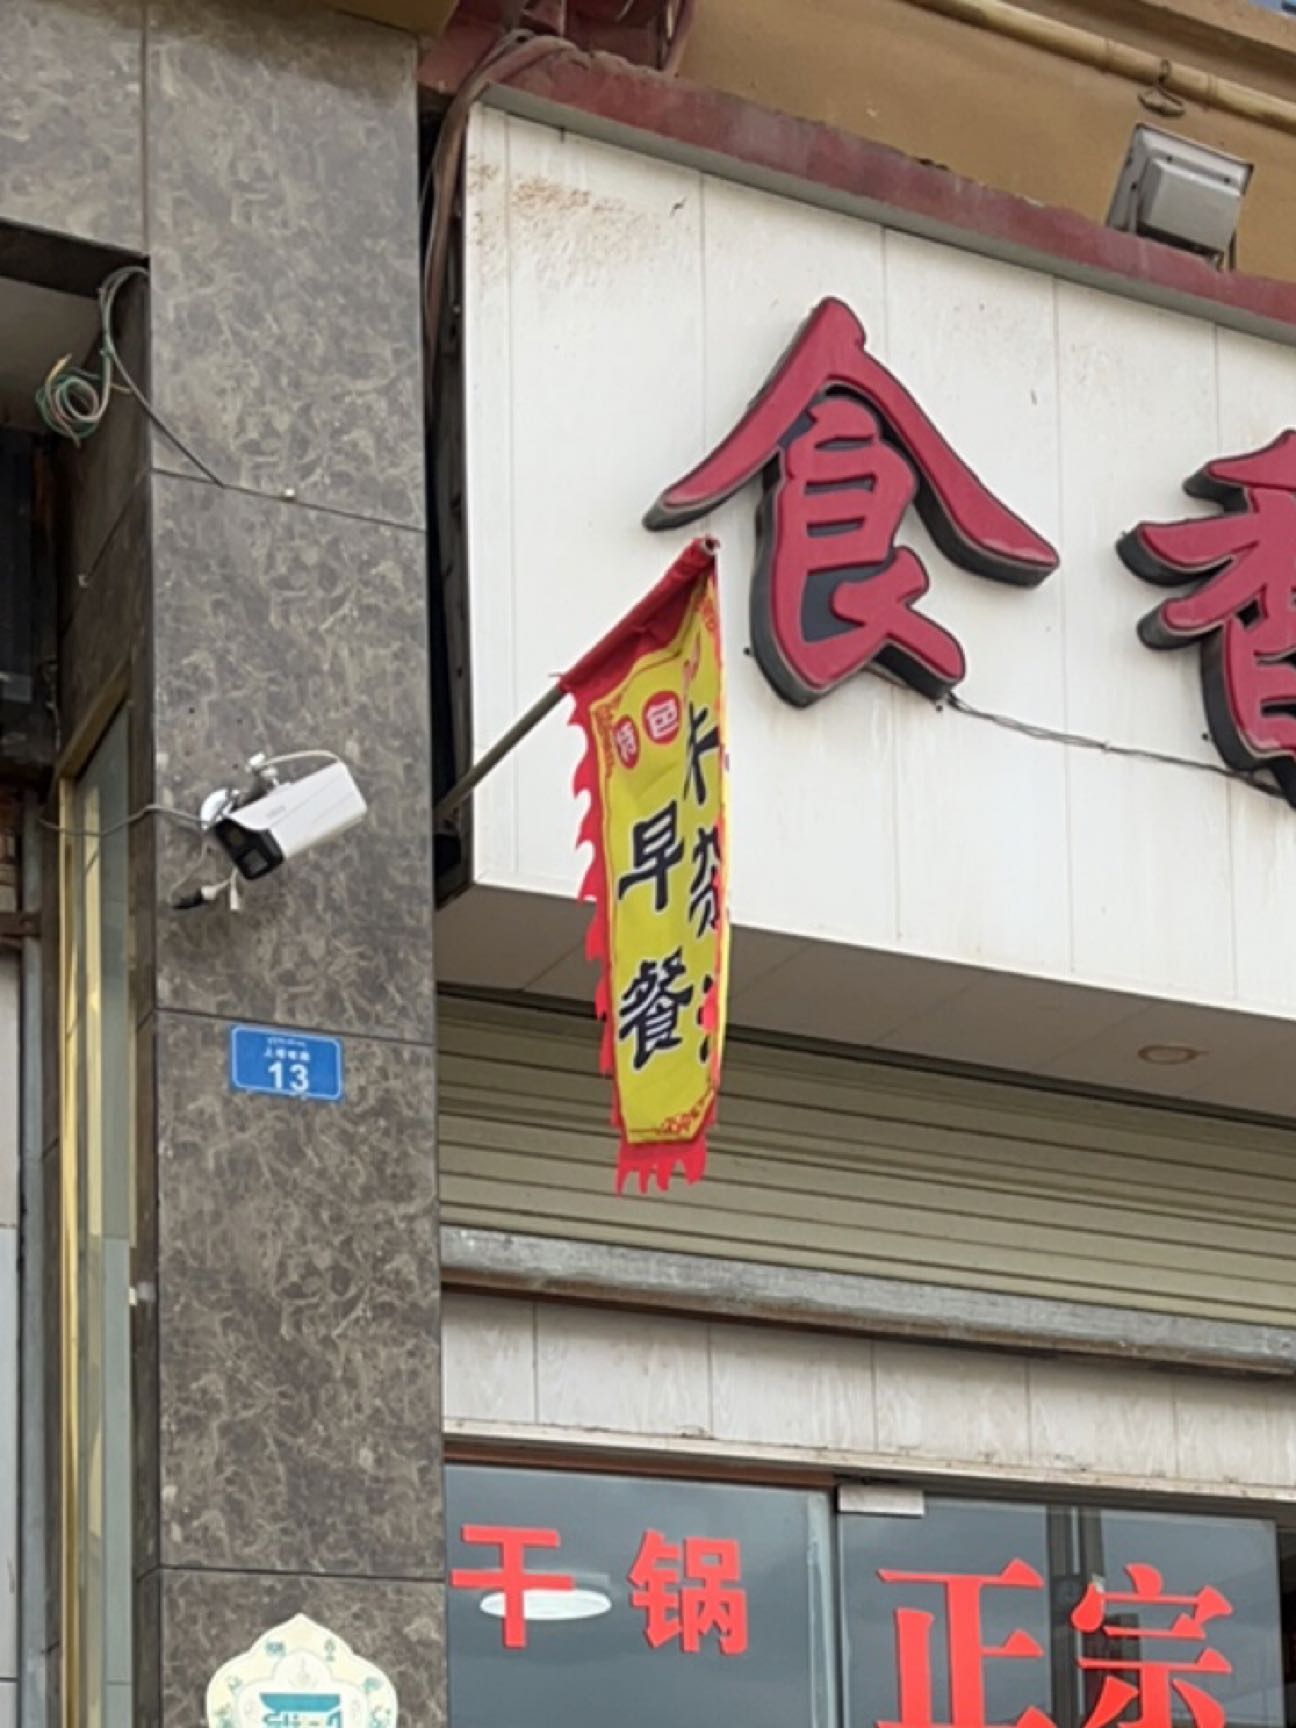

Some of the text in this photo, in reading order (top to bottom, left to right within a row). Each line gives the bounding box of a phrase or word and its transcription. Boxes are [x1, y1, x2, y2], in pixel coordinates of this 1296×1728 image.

[619, 800, 693, 1070] 早餐
[267, 1060, 309, 1094] 13
[449, 1524, 749, 1656] 干锅
